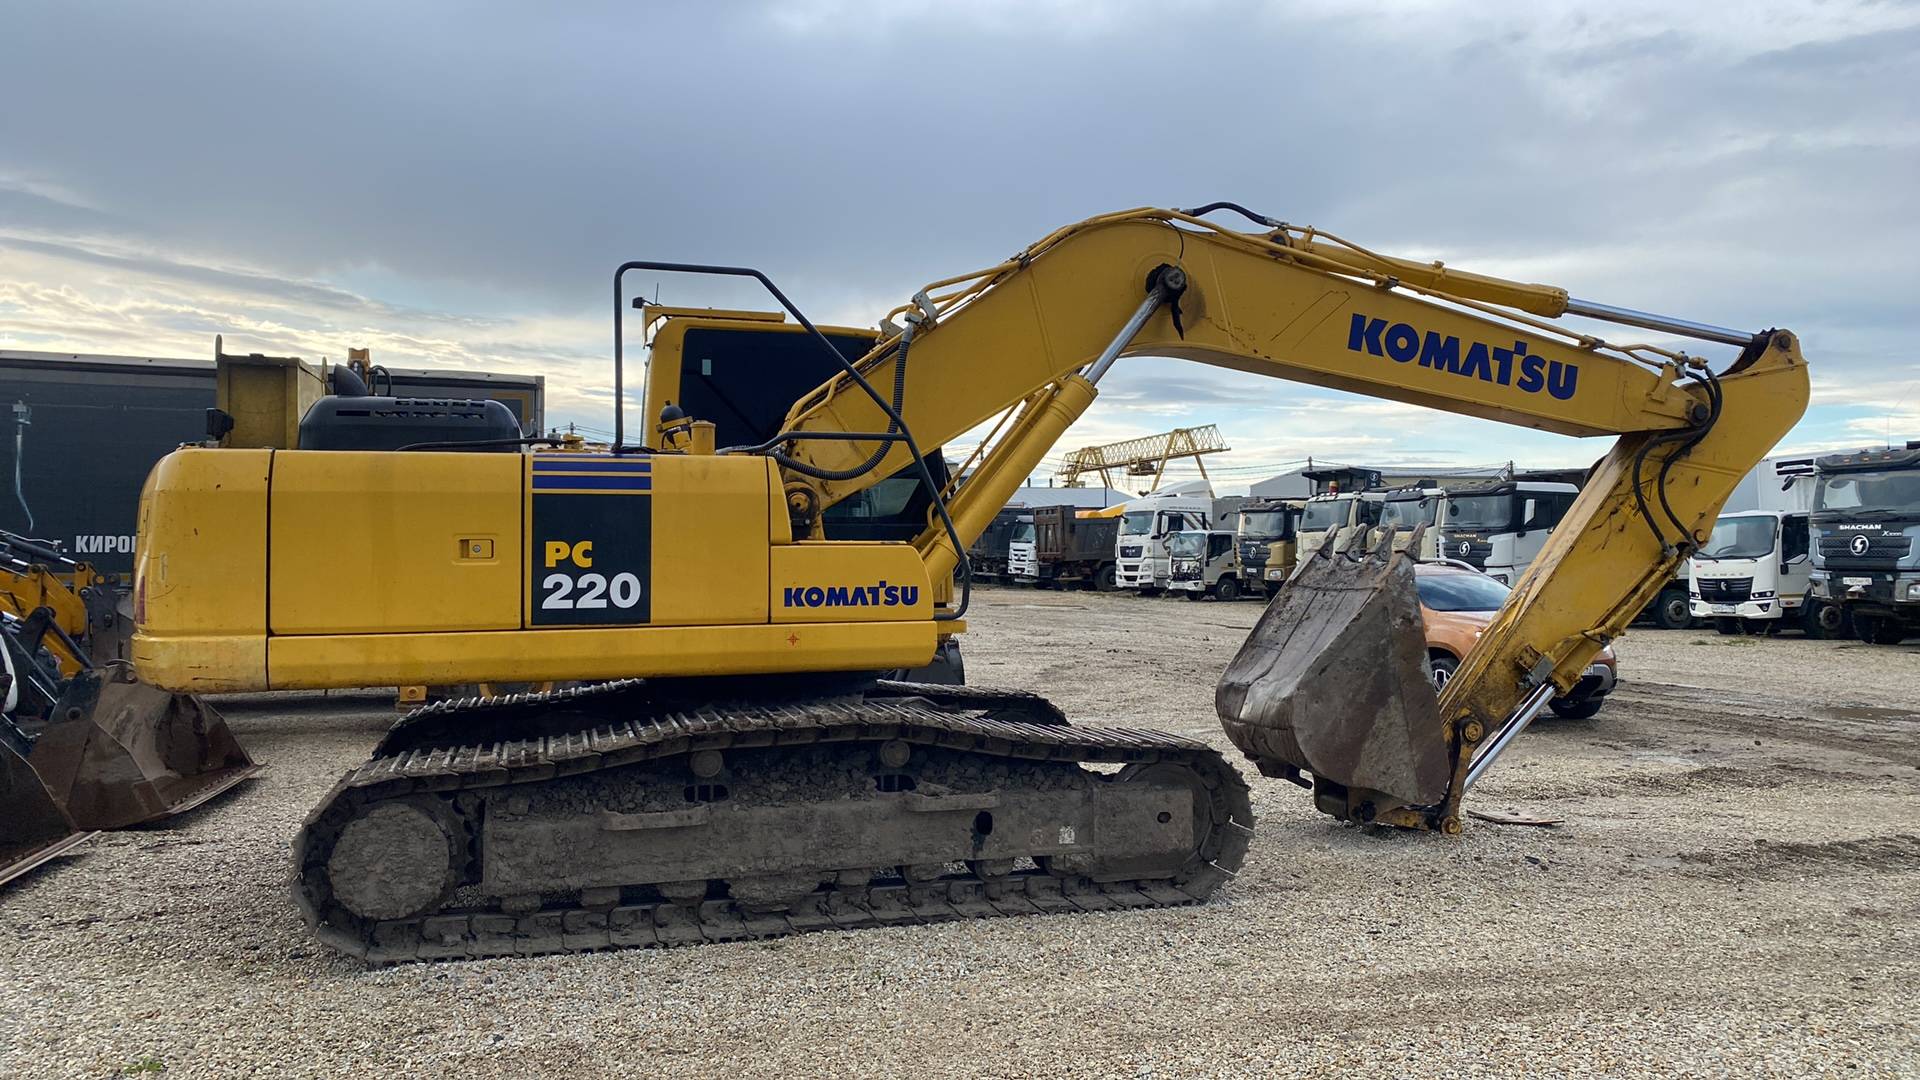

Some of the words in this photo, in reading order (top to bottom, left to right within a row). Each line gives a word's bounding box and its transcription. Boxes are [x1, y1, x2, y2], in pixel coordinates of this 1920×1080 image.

[1347, 313, 1578, 400] KOMATSU
[545, 541, 593, 568] PC
[541, 572, 641, 609] 220
[784, 580, 919, 607] KOMATSU
